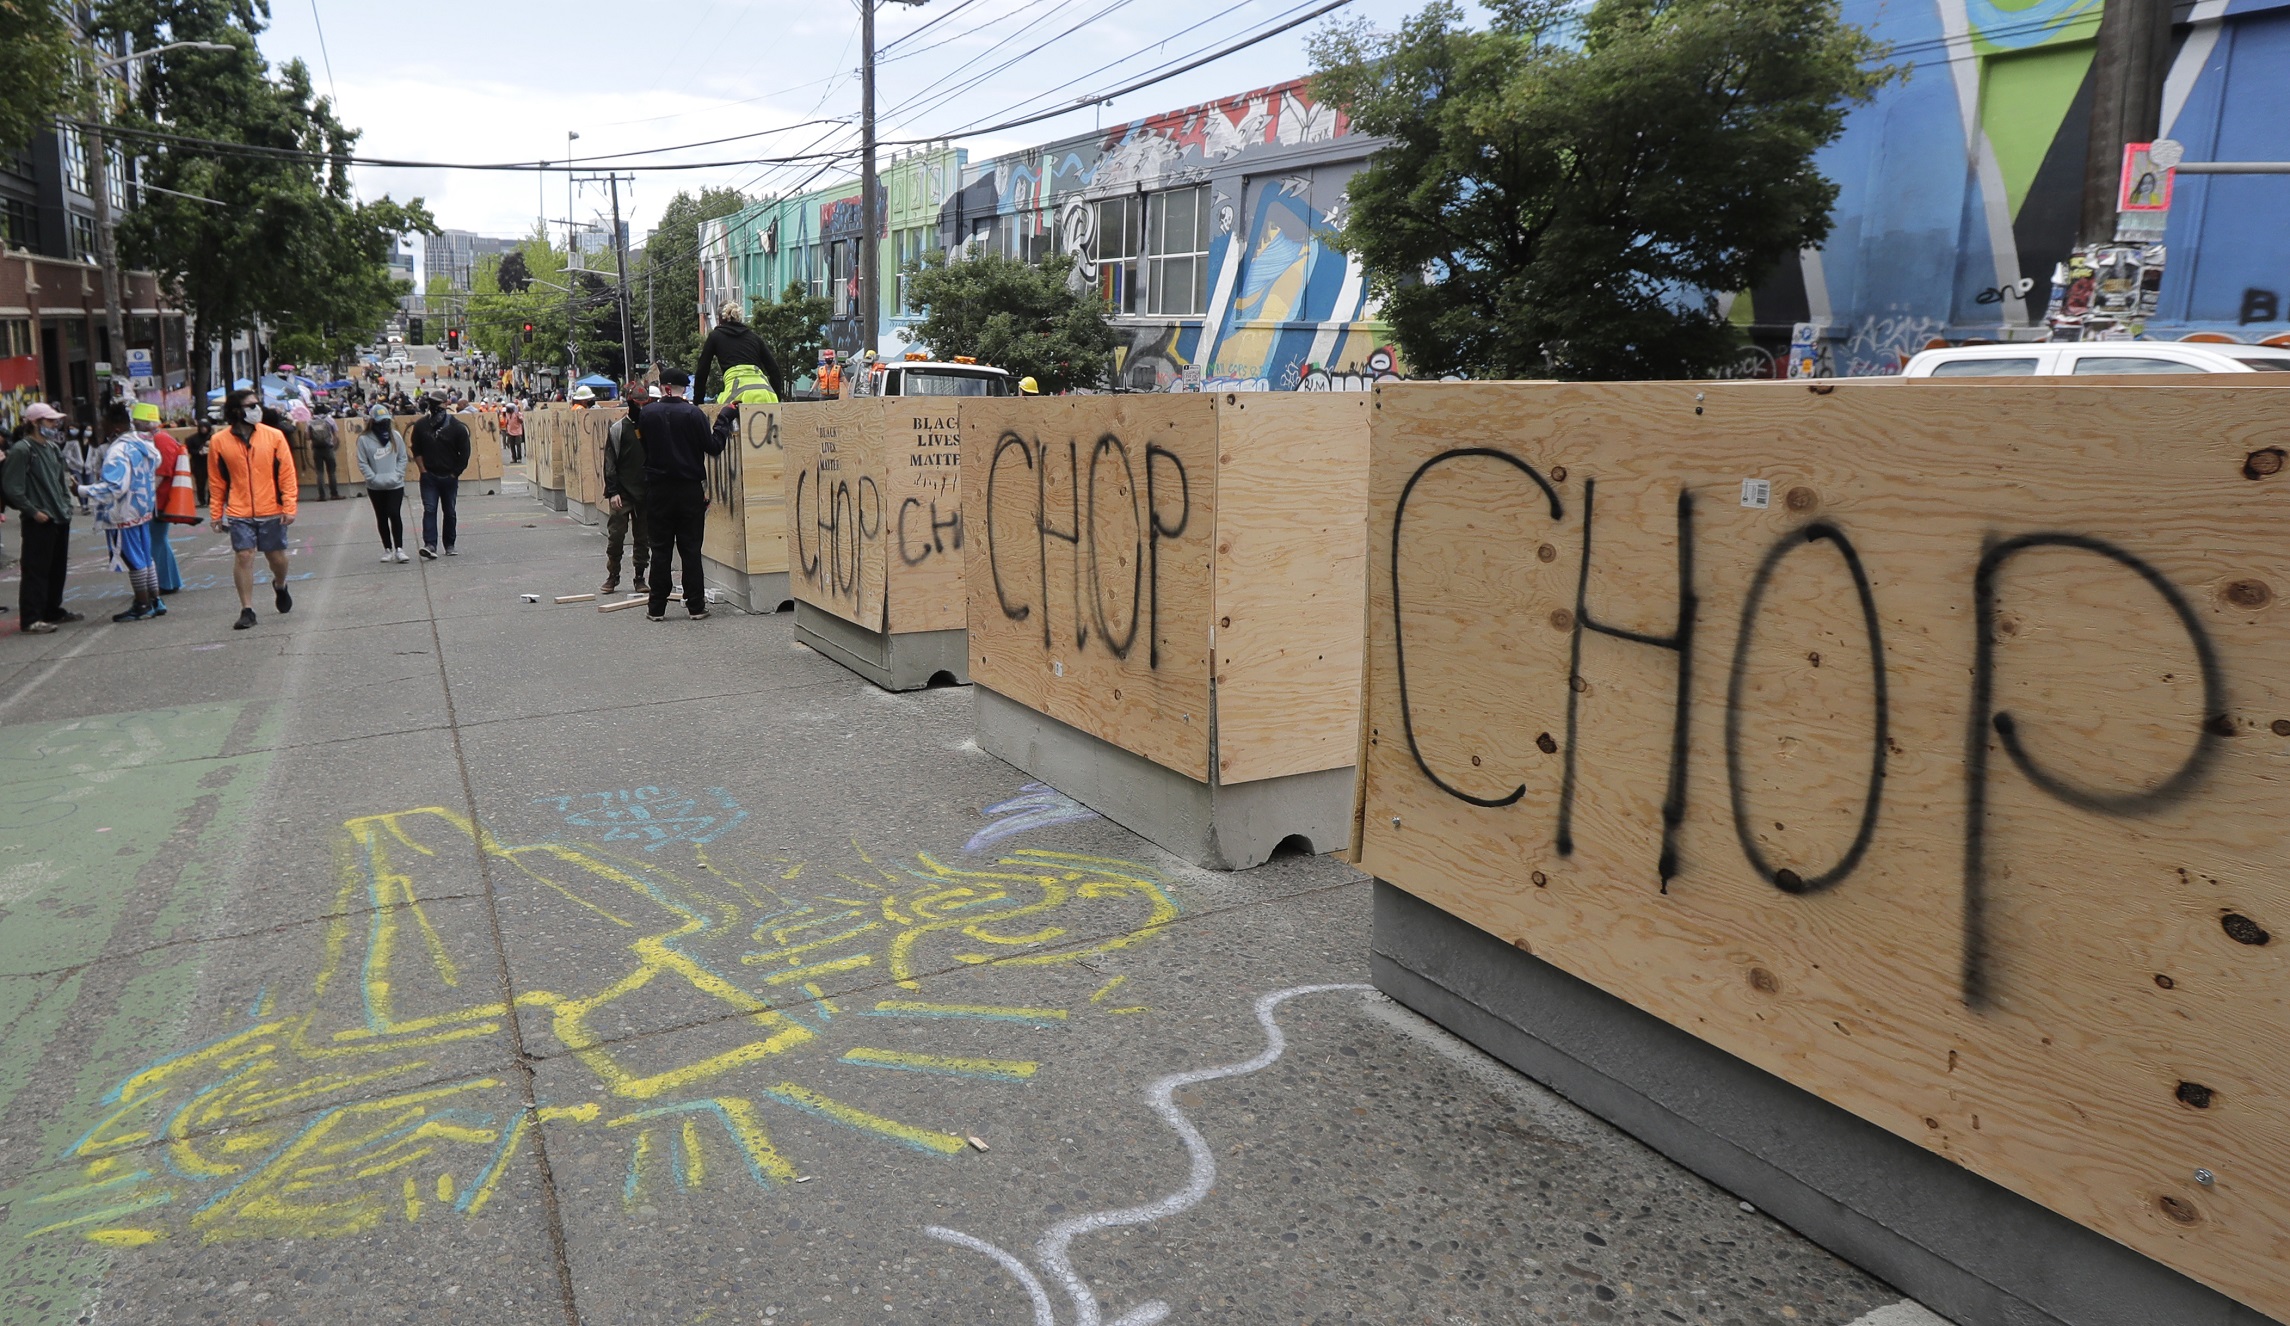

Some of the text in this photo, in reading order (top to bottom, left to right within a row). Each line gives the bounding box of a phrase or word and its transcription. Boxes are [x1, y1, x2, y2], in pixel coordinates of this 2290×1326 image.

[797, 460, 880, 617] CHOP
[917, 434, 961, 447] LIVES
[987, 431, 1189, 670] CHOP
[1392, 446, 2227, 1012] CHOP
